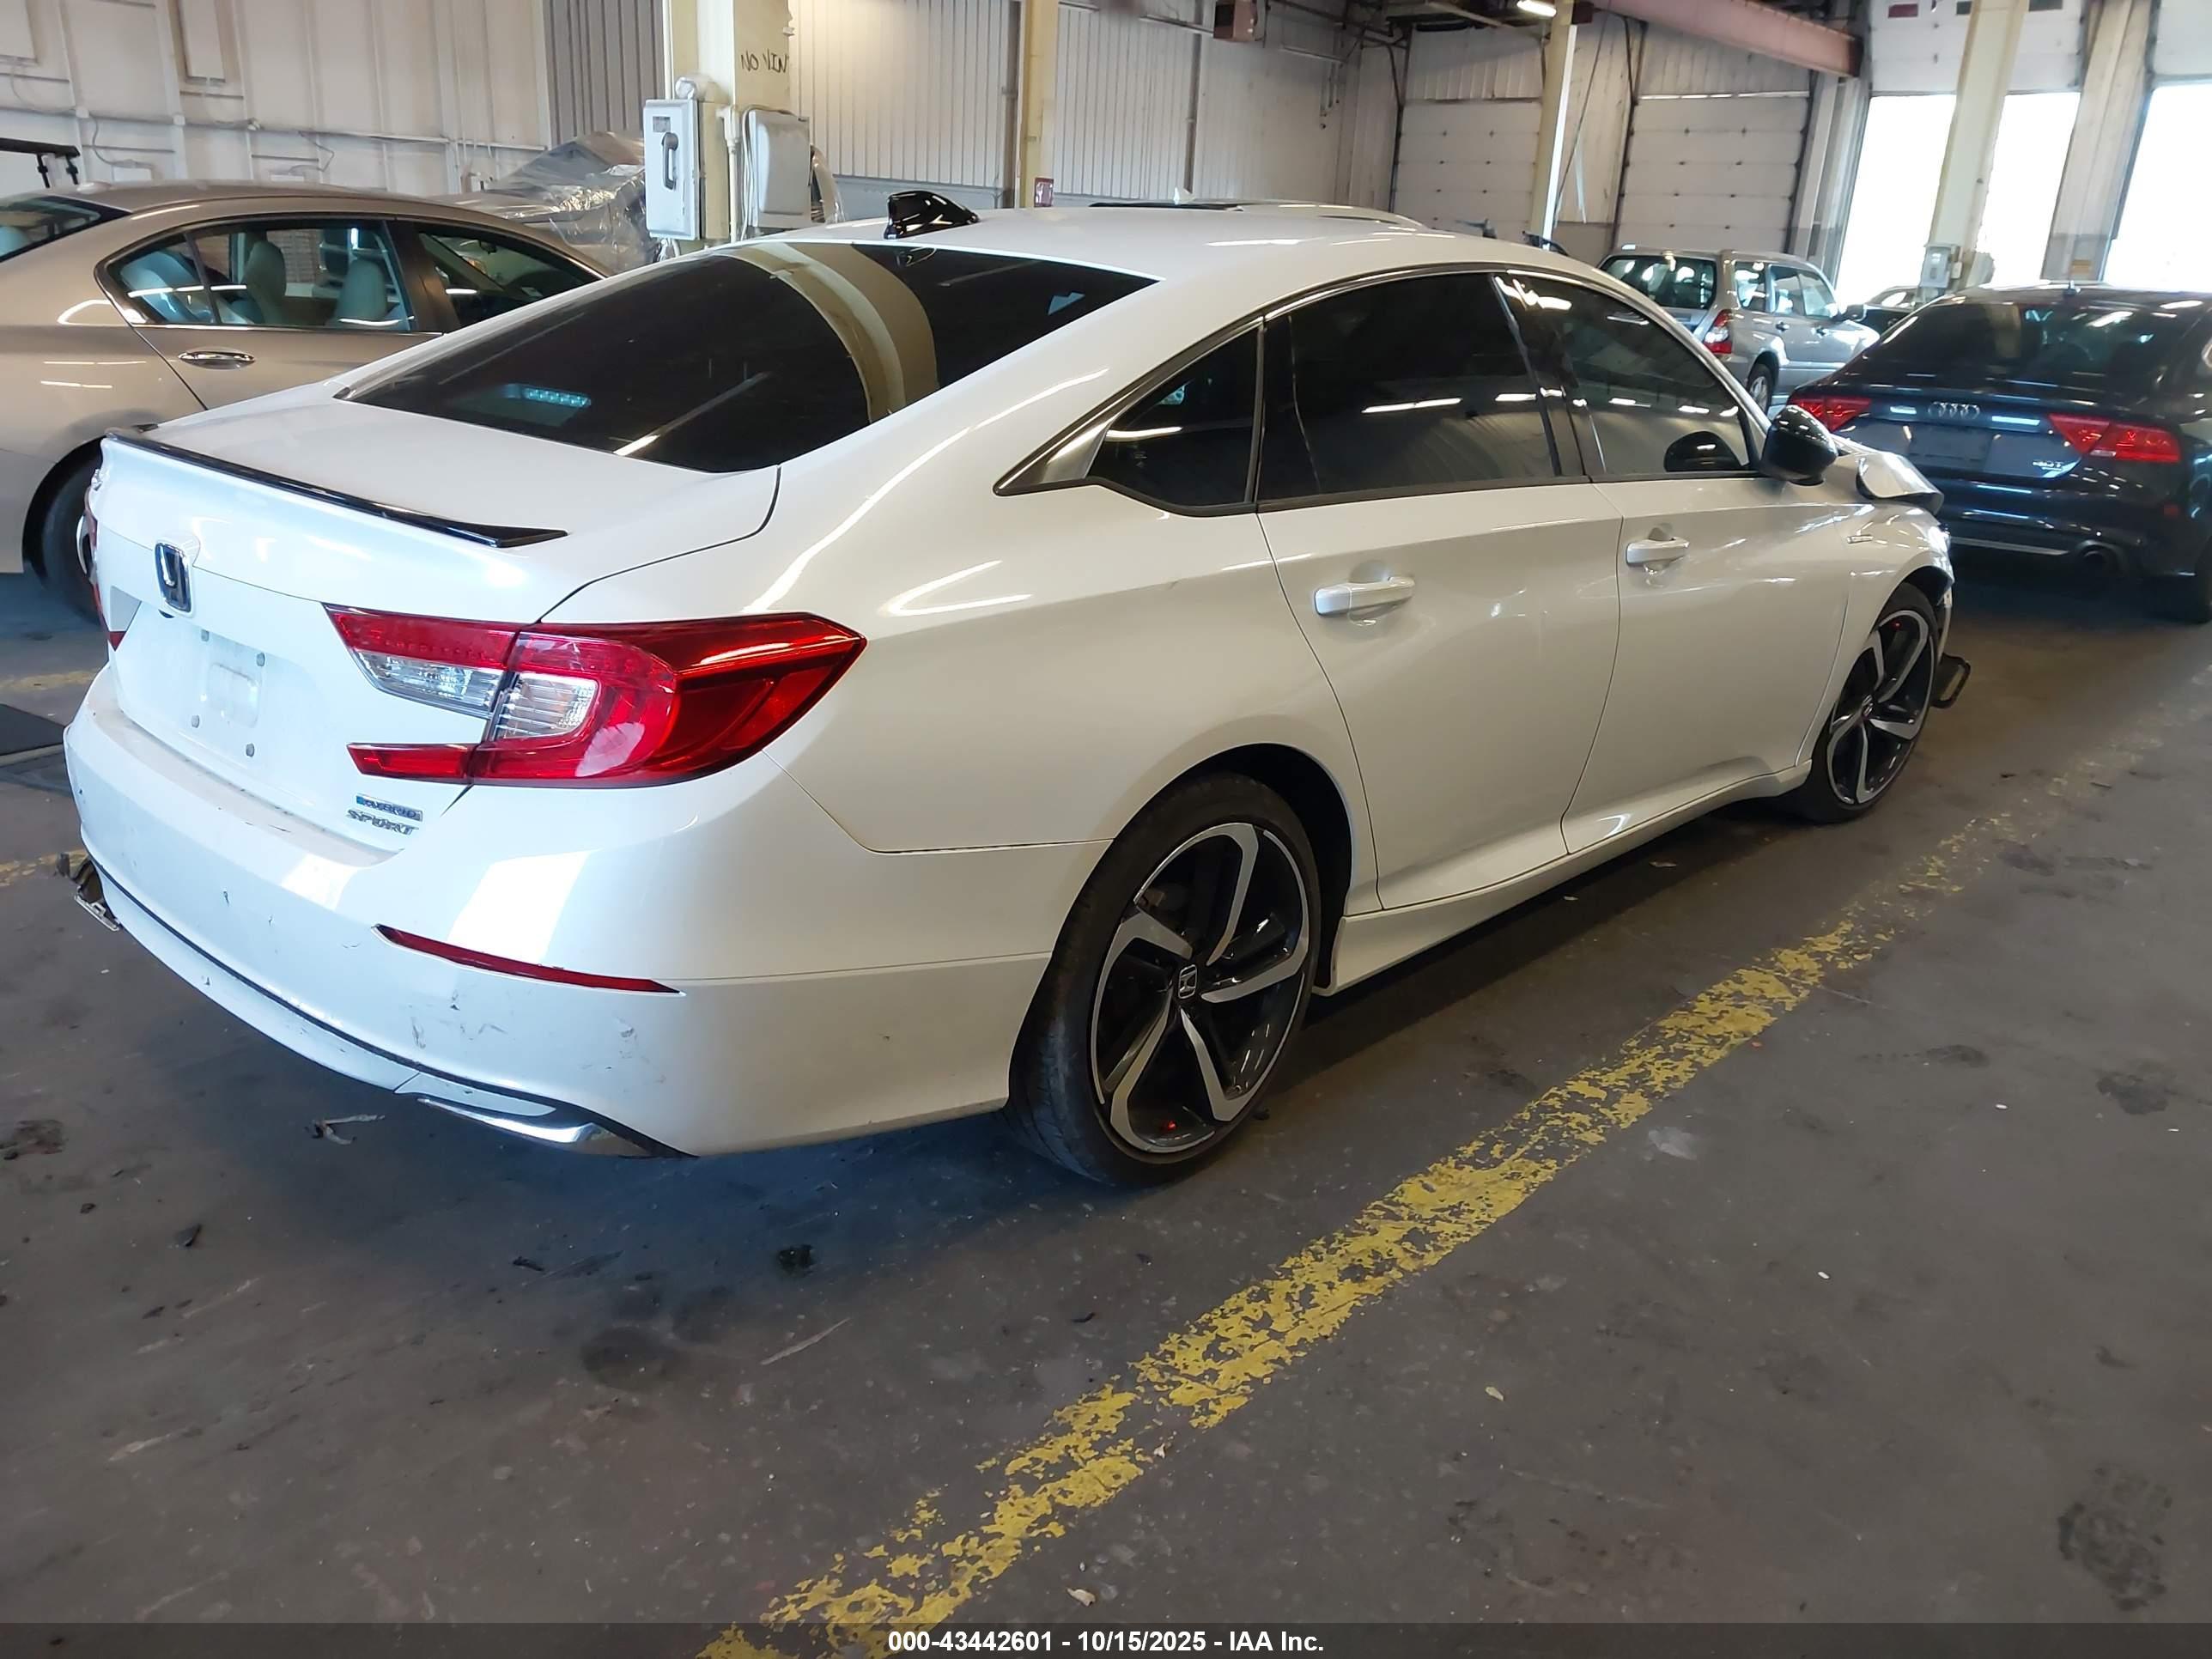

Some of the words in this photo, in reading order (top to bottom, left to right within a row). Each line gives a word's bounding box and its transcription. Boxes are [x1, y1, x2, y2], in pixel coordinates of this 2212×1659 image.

[741, 50, 759, 71] NO
[762, 48, 787, 73] VIN
[347, 810, 419, 836] SPORT
